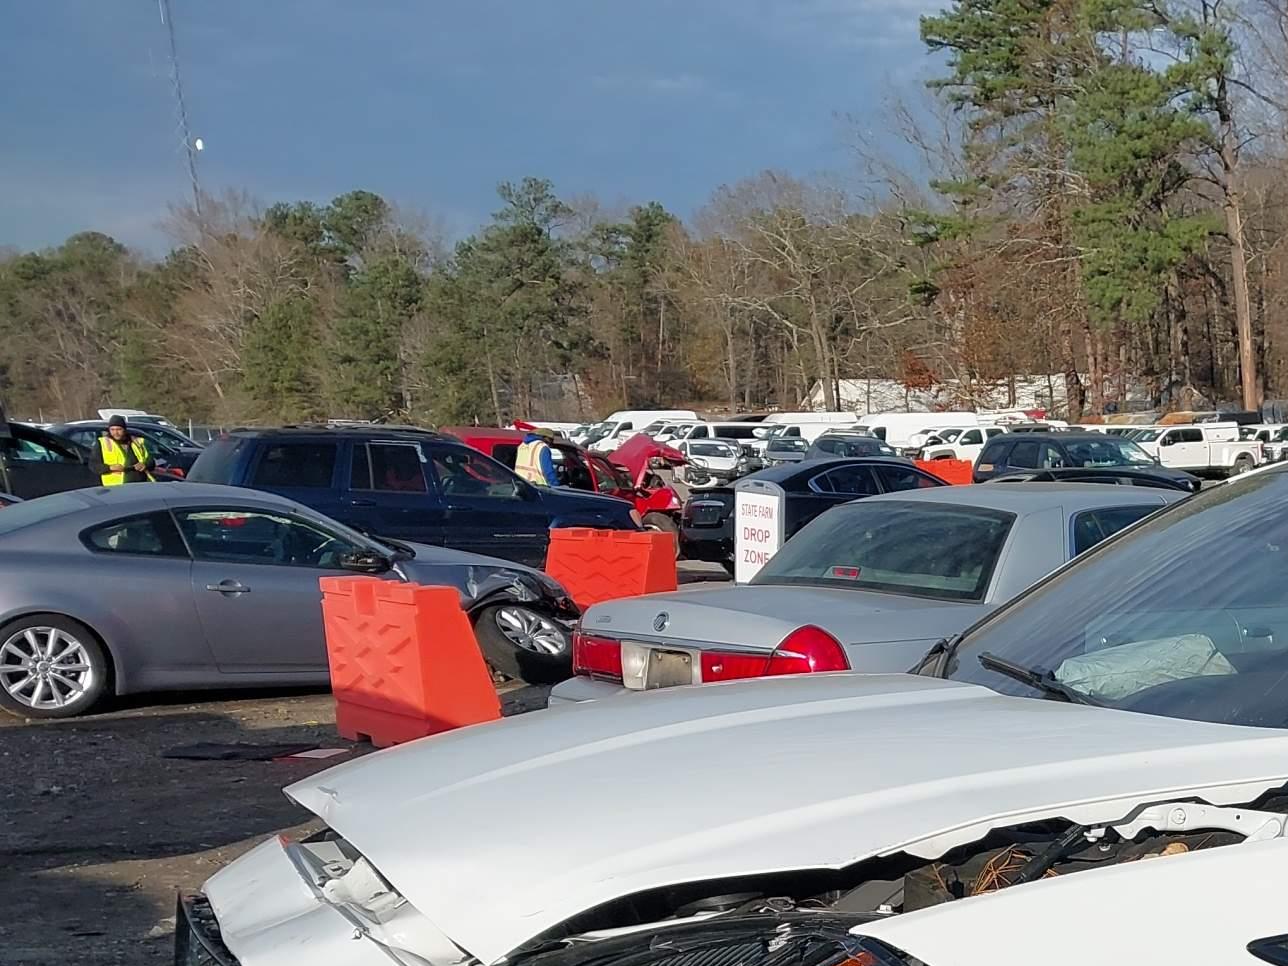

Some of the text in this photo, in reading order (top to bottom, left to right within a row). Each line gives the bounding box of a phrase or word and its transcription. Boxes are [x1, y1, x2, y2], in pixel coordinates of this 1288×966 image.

[741, 503, 774, 520] STATE FARM
[743, 527, 771, 543] DROP
